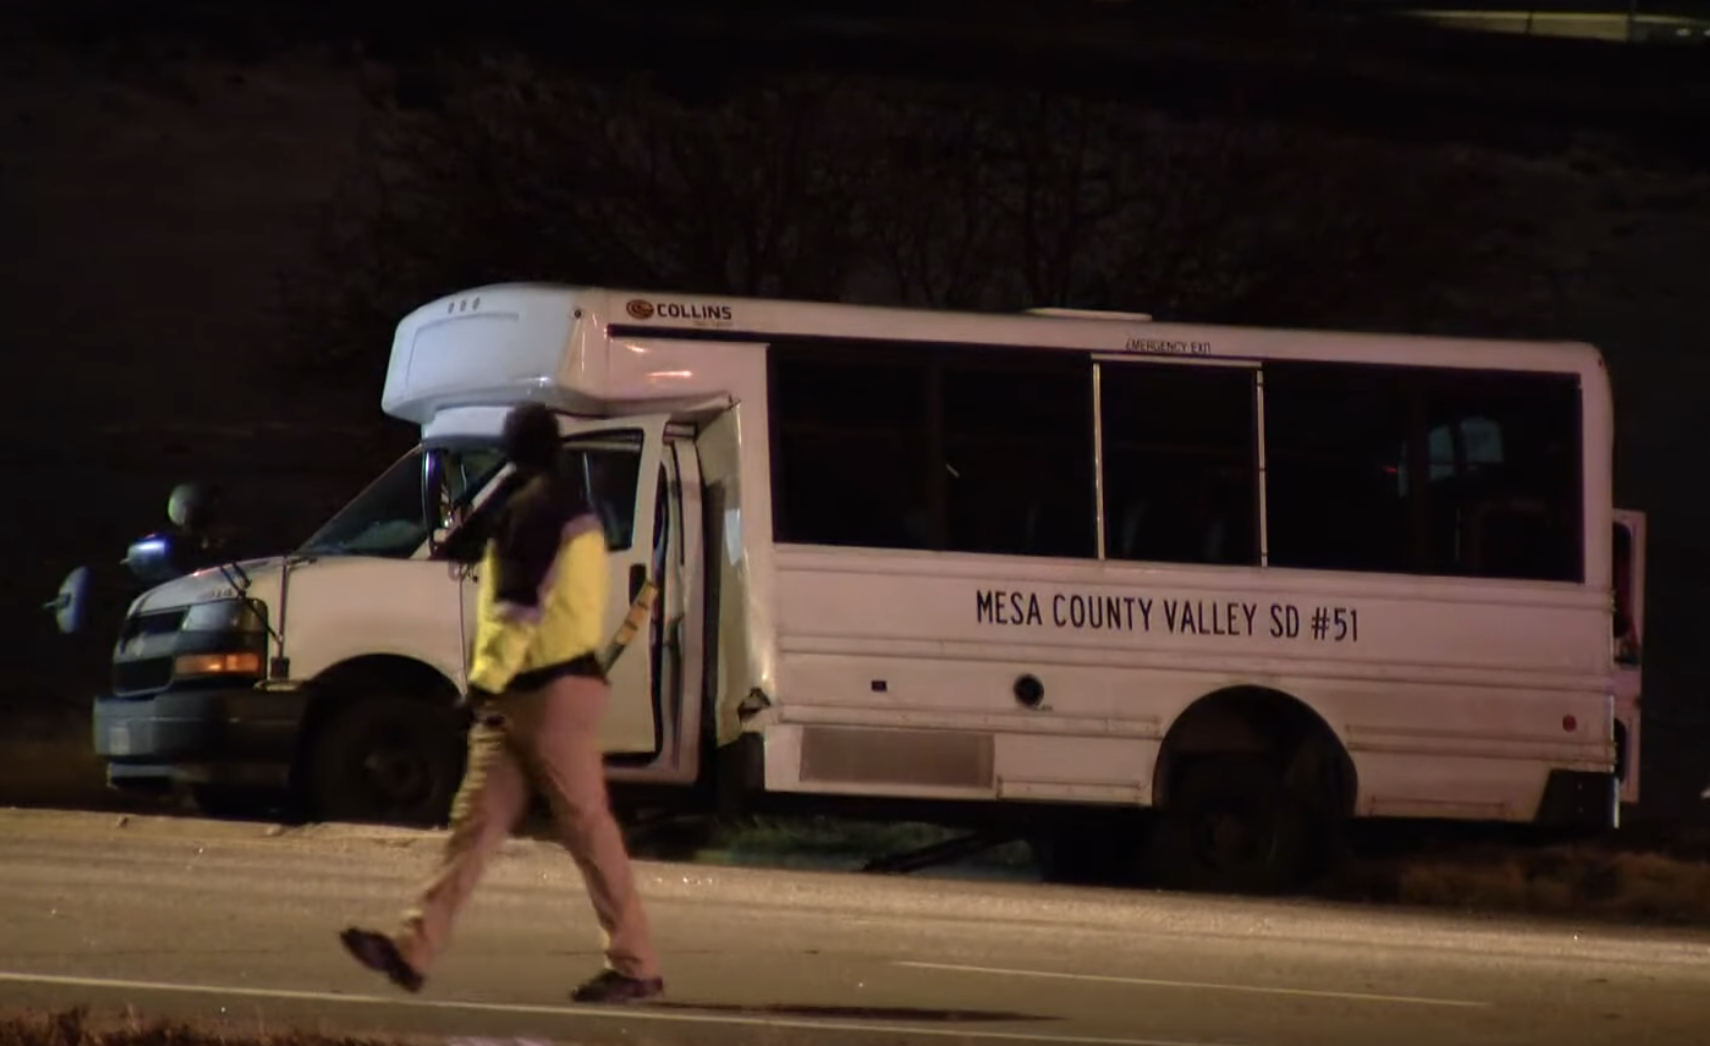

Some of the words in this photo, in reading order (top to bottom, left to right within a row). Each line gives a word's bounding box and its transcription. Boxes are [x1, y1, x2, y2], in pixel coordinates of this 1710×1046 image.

[657, 303, 732, 320] COLLINS
[976, 590, 1042, 625] MESA
[1053, 595, 1153, 632] COUNTY
[1164, 600, 1257, 636] VALLEY
[1270, 604, 1299, 638] SD
[1311, 607, 1358, 642] #51
